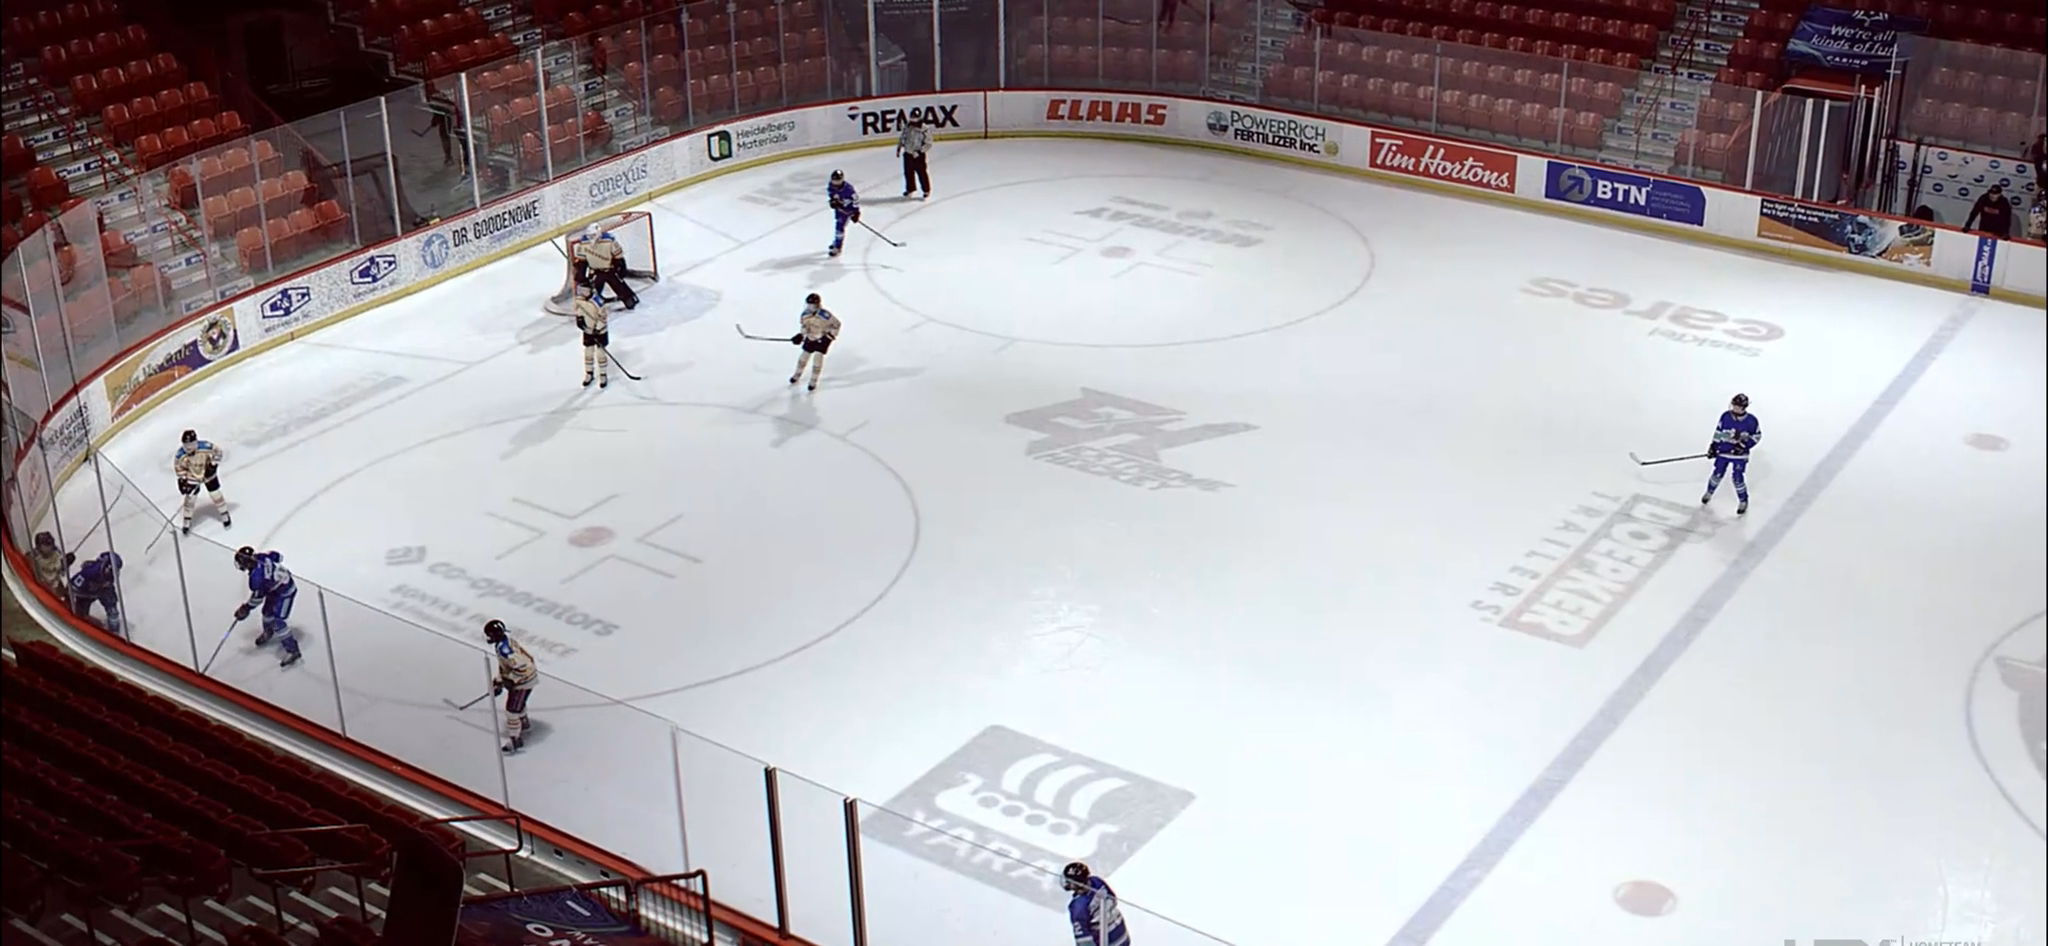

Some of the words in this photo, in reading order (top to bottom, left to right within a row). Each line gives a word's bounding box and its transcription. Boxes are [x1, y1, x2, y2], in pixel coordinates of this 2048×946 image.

[1811, 34, 1850, 50] kinds
[1853, 42, 1871, 53] of
[1830, 25, 1872, 39] We're
[1874, 31, 1895, 41] all
[1046, 99, 1167, 126] CLAAS
[736, 119, 795, 140] Heidelberg
[737, 133, 788, 151] Materials
[1234, 128, 1297, 150] FERTILIZER
[1299, 140, 1321, 154] Inc.
[1375, 137, 1415, 171] Tim
[589, 154, 648, 197] conexus
[1596, 179, 1649, 206] BTN
[452, 228, 472, 247] DR.
[473, 199, 540, 239] GOODENOWE
[1519, 277, 1785, 342] cares
[427, 561, 620, 637] co-operators
[903, 809, 1063, 891] YARA
